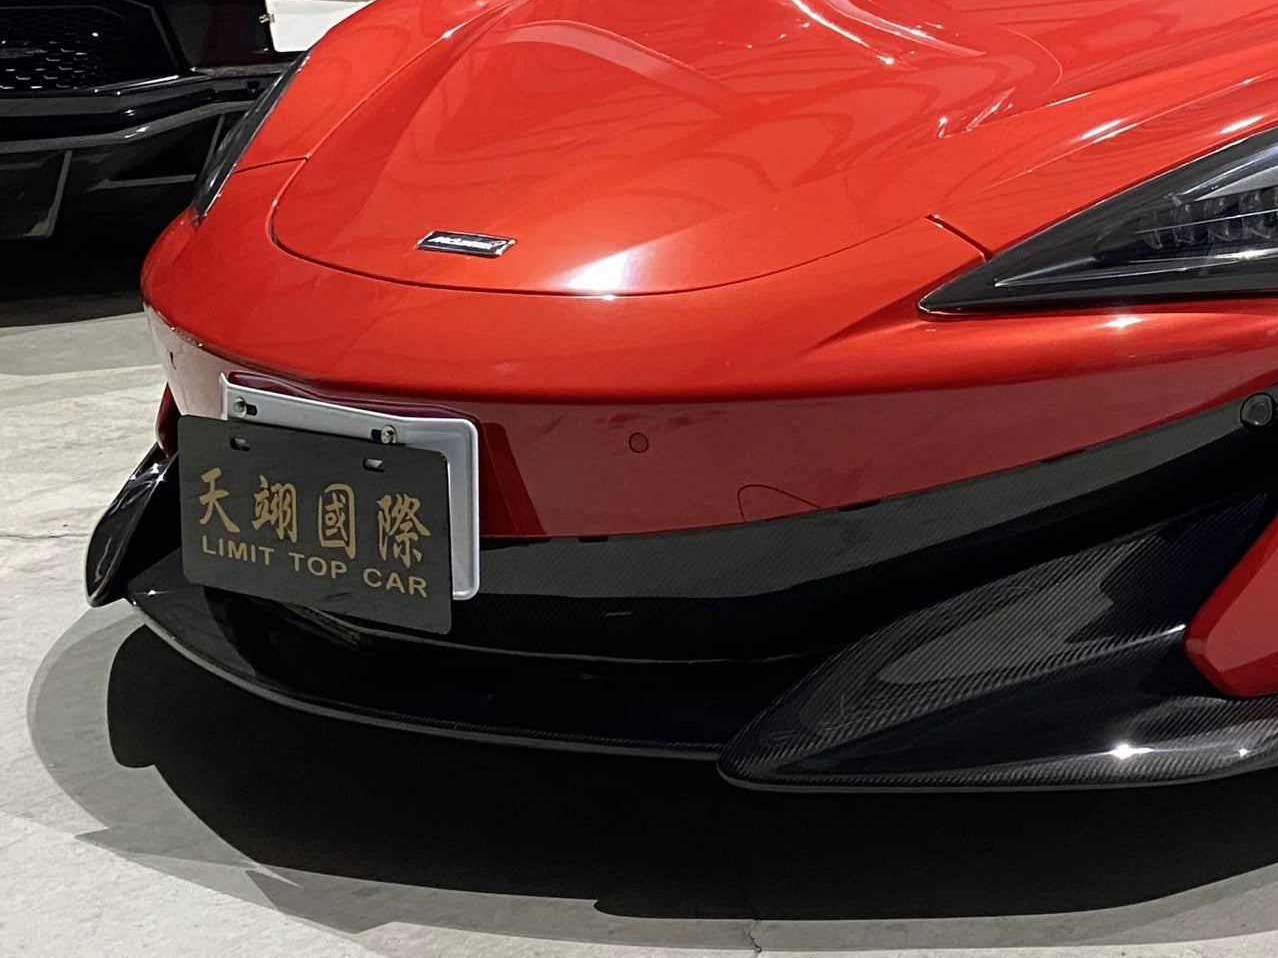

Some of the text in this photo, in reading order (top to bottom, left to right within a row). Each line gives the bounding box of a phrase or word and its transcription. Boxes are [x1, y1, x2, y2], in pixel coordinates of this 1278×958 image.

[202, 535, 428, 598] LIMIT TOP CAR
